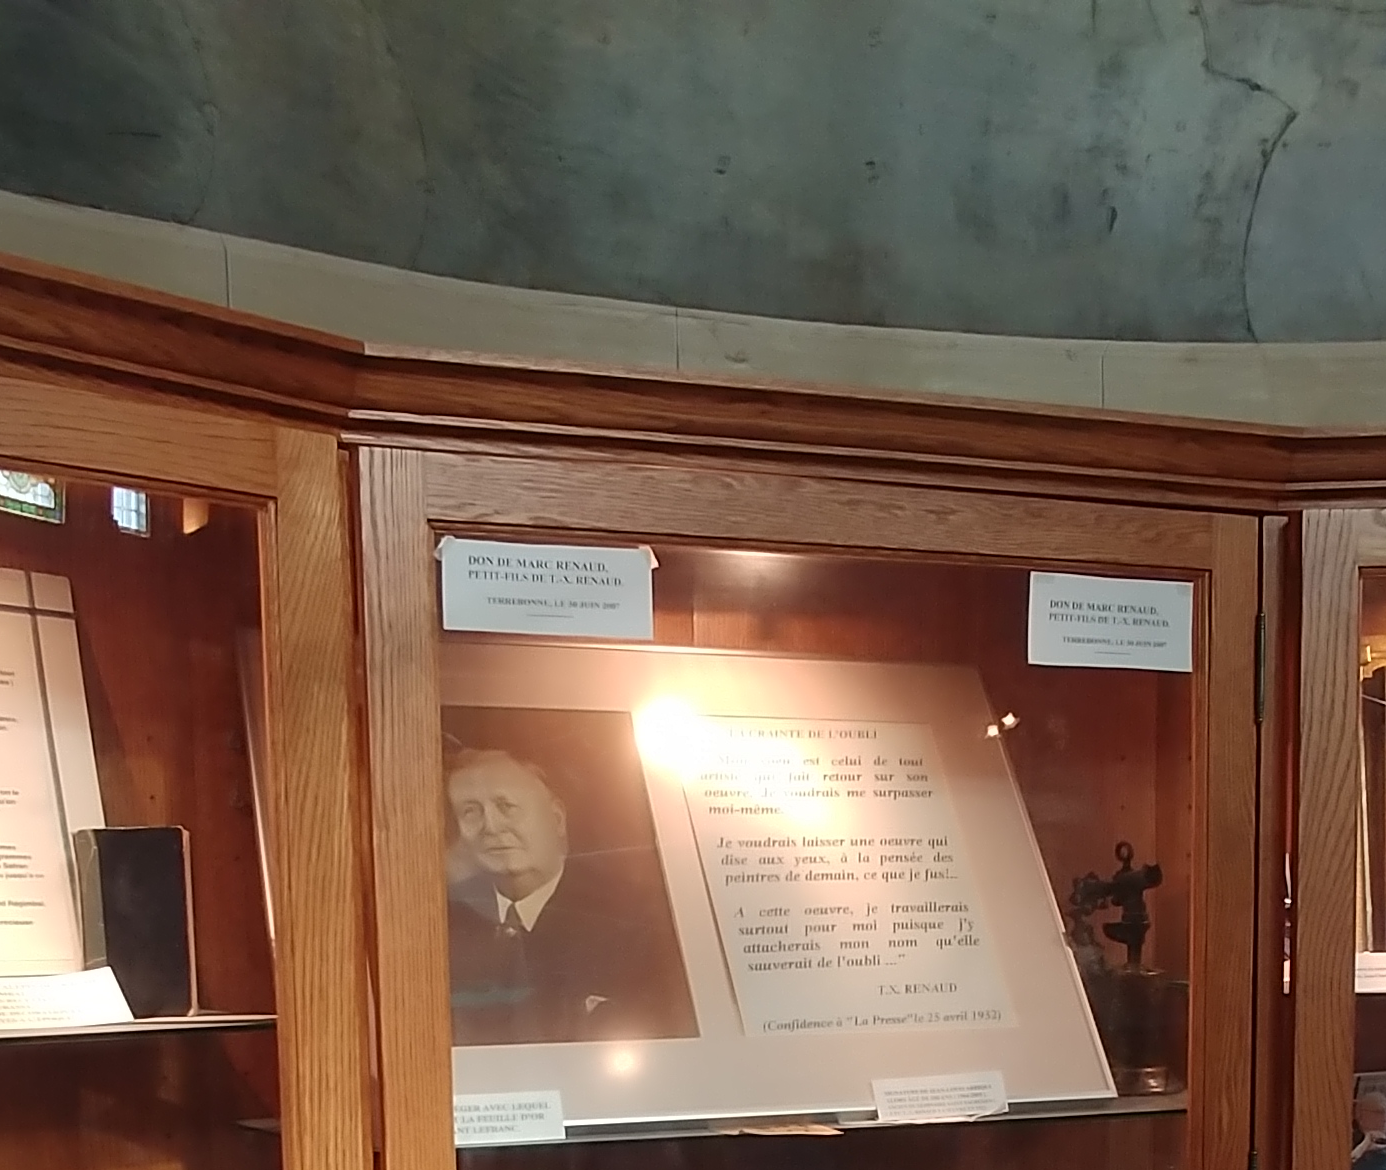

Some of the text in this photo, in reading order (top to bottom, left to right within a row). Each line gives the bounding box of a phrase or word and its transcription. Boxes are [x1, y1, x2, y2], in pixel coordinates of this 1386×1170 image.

[468, 555, 608, 573] DON DE MARC RENAUD,
[468, 570, 528, 581] PETIT-FILS
[532, 574, 548, 583] DE
[1050, 599, 1069, 609] DON
[1072, 602, 1085, 610] DE
[1087, 602, 1115, 612] MARC
[1049, 613, 1096, 623] PETIT-FILS
[1098, 616, 1111, 624] DE
[808, 730, 824, 739] DE
[828, 729, 878, 739] L'OUBLI
[831, 756, 862, 766] celui
[873, 756, 888, 766] de
[899, 757, 923, 766] tout
[823, 773, 863, 781] retour
[874, 773, 894, 782] sur
[907, 773, 929, 782] son
[846, 790, 866, 798] me
[873, 789, 933, 800] surpasser
[717, 836, 948, 849] Je voudrais laisser une oeuvre qui
[721, 854, 748, 866] dise
[759, 856, 784, 865] aux
[794, 855, 830, 867] yeux,
[858, 852, 870, 864] la
[880, 853, 923, 866] pensée
[933, 852, 954, 863] des
[725, 870, 921, 886] peintres de demain, ce que je
[759, 906, 790, 917] cette
[804, 905, 854, 917] oeuvre,
[866, 904, 878, 917] je
[891, 901, 969, 914] travaillerais
[738, 923, 789, 935] surtout
[804, 923, 837, 936] pour
[852, 921, 877, 932] moi
[893, 920, 944, 933] puisque
[743, 935, 980, 954] attacherais mon nom qu'elle
[748, 955, 881, 972] sauverait de l'oubli
[905, 983, 957, 994] RENAUD
[943, 1011, 969, 1023] avril
[483, 1104, 509, 1112] AVEC
[512, 1101, 551, 1111] LEQUEL
